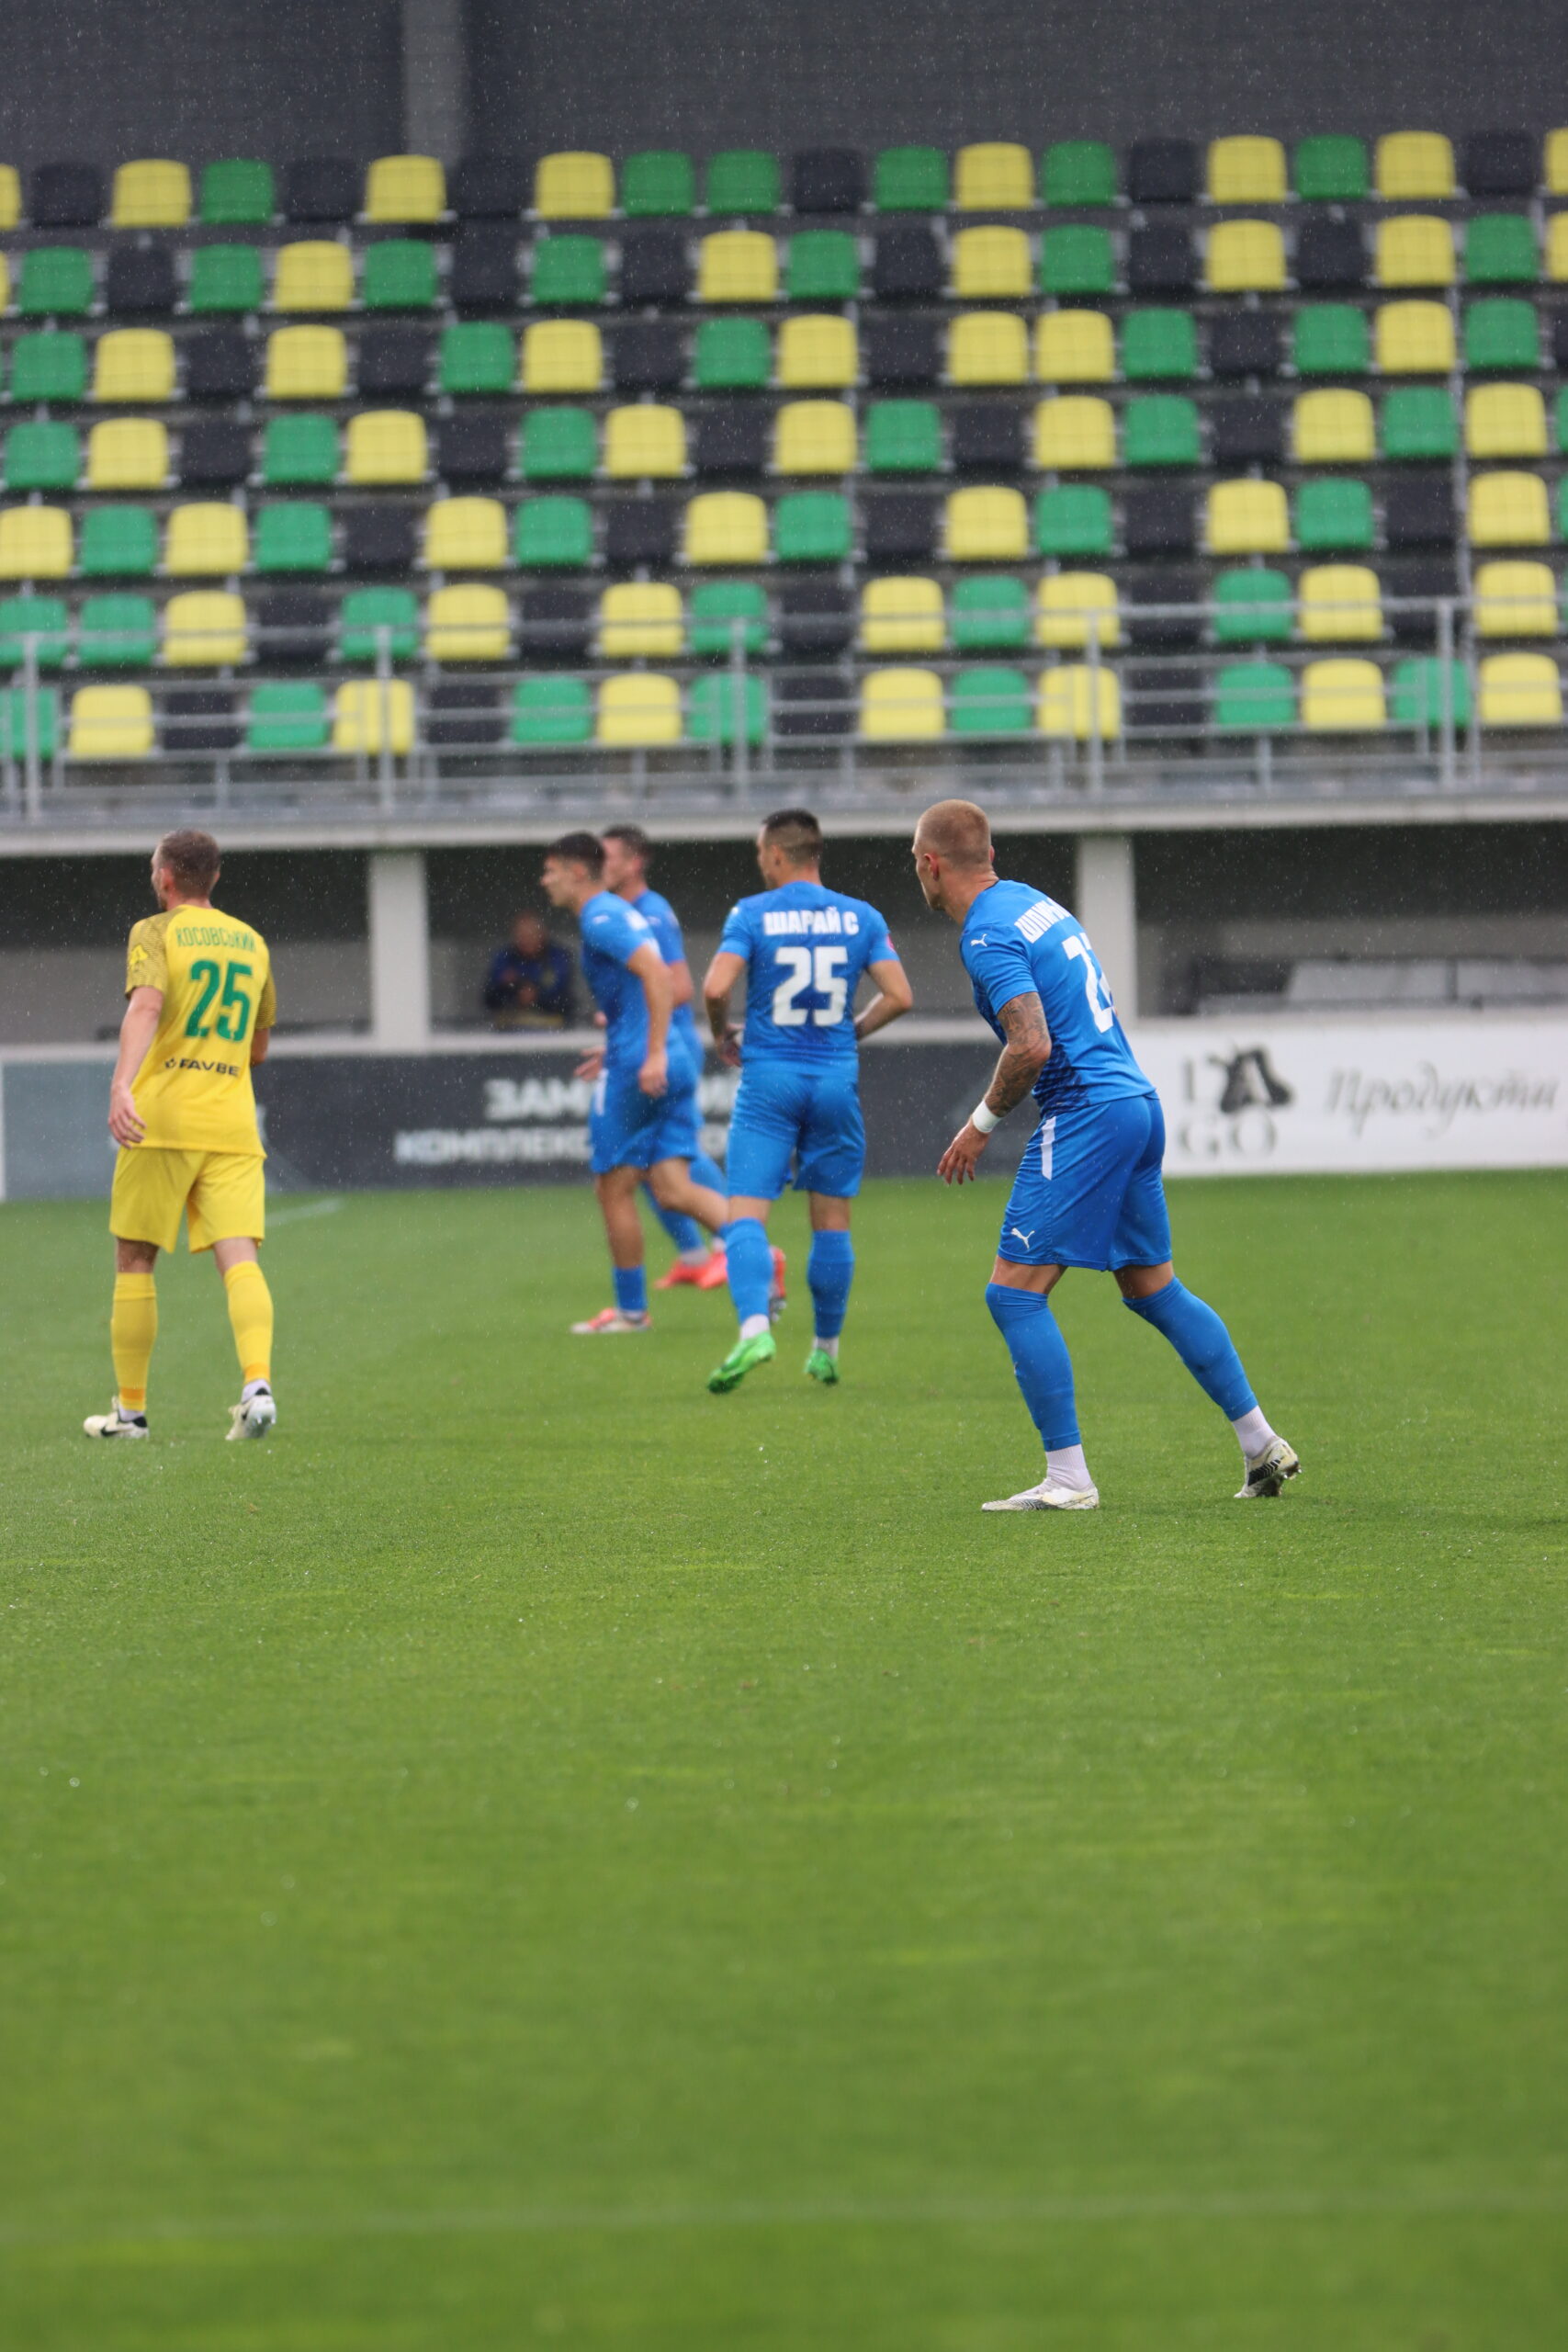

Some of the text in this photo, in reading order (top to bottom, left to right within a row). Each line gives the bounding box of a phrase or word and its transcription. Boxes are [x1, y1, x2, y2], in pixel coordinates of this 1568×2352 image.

[762, 906, 841, 936] ШАРАЙ
[185, 959, 254, 1043] 25
[773, 945, 849, 1026] 25
